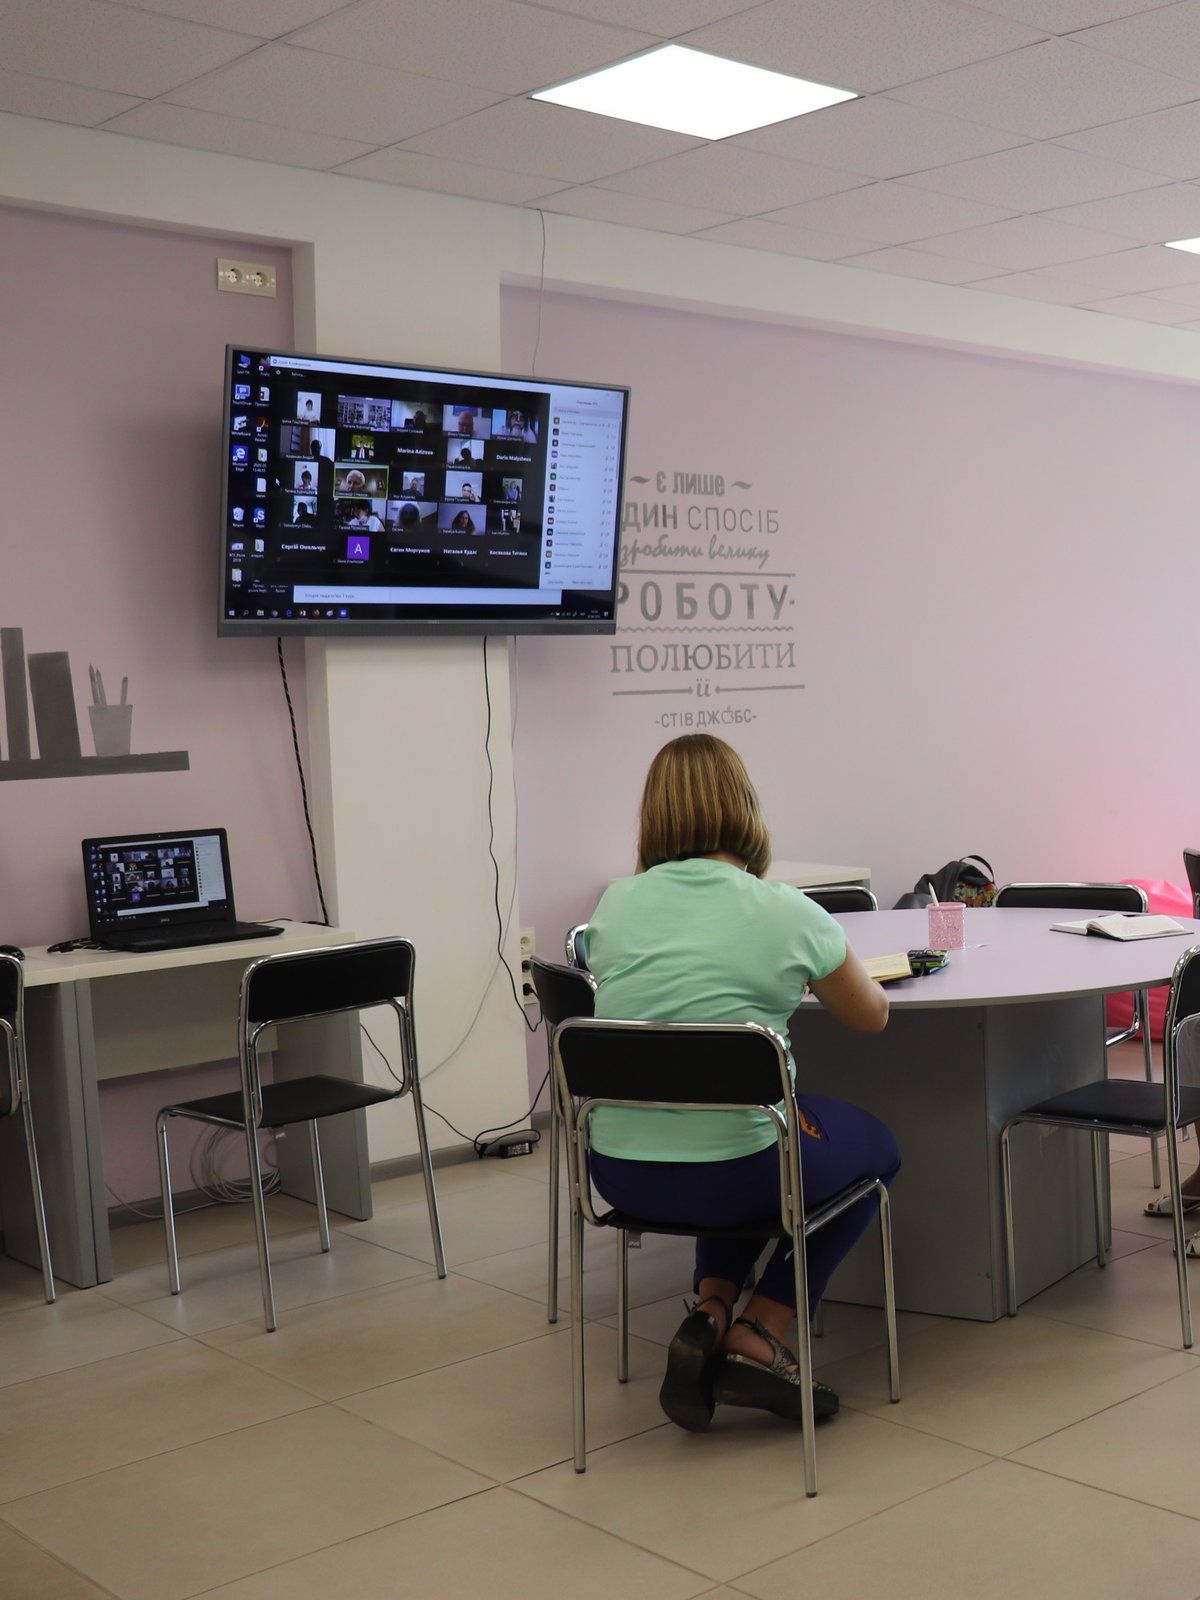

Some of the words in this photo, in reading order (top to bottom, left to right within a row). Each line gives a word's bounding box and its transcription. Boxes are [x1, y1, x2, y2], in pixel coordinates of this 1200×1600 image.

[621, 502, 678, 532] ДИН
[687, 505, 780, 533] СПОСІБ
[610, 642, 797, 673] ПОЛЮБИТИ
